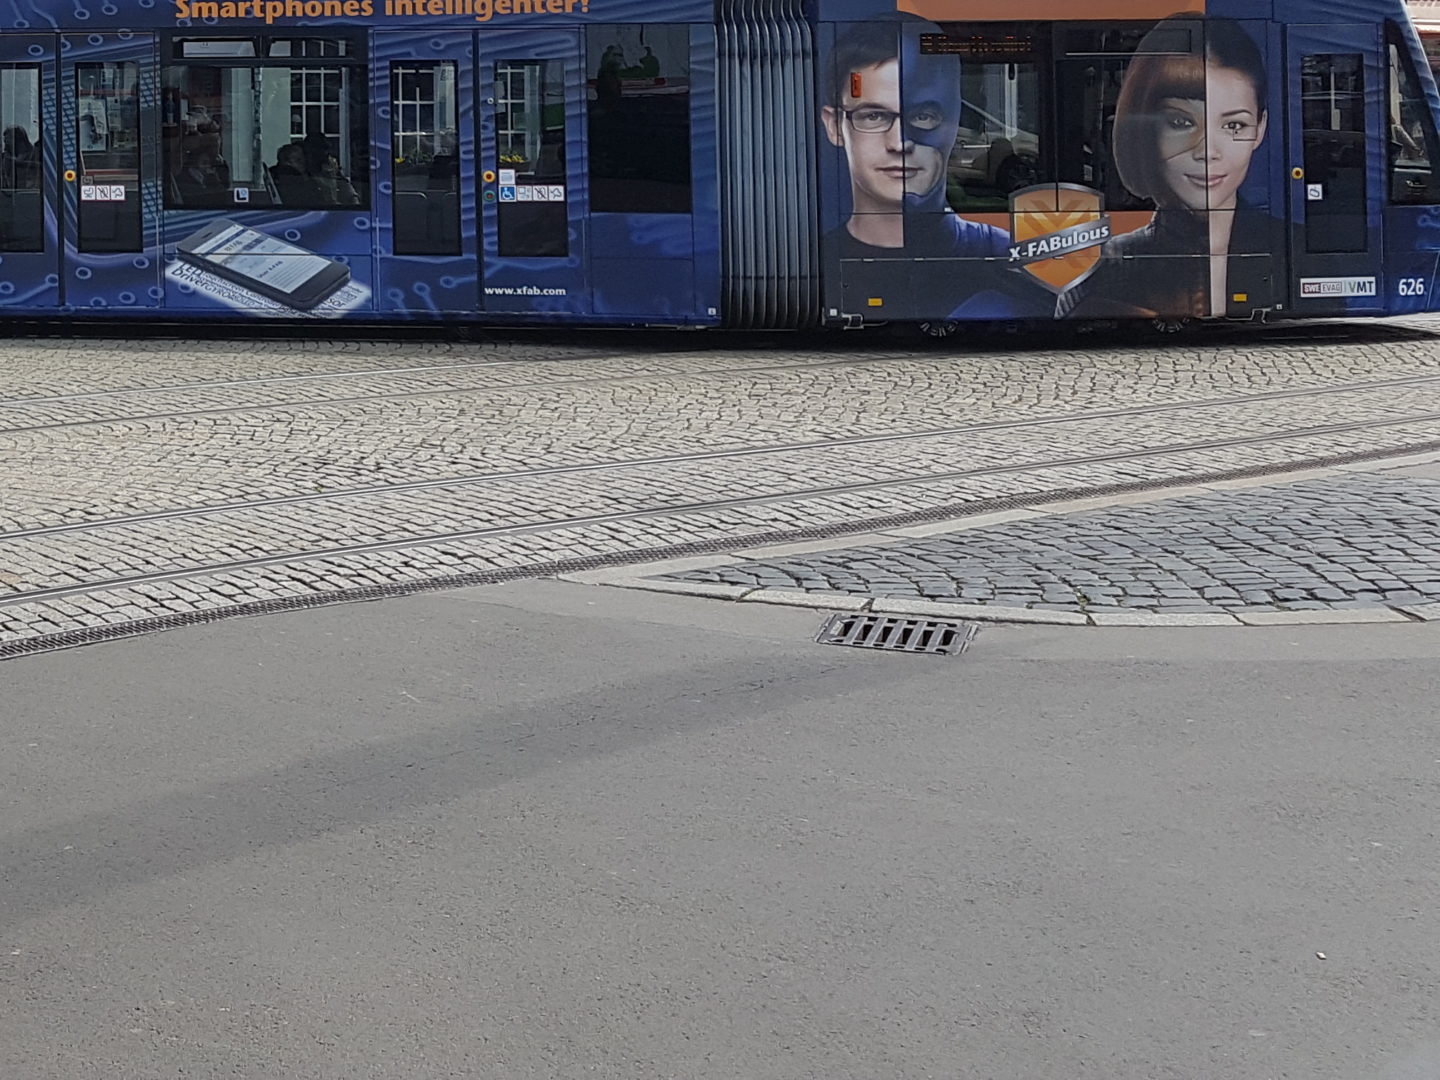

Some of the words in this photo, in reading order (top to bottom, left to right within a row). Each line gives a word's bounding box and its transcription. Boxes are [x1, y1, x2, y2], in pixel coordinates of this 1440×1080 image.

[1008, 225, 1110, 262] X-FABulous
[484, 286, 567, 296] www.xfab.com
[1322, 282, 1341, 293] EVAG
[1348, 280, 1374, 294] VMT
[1398, 278, 1424, 296] 626
